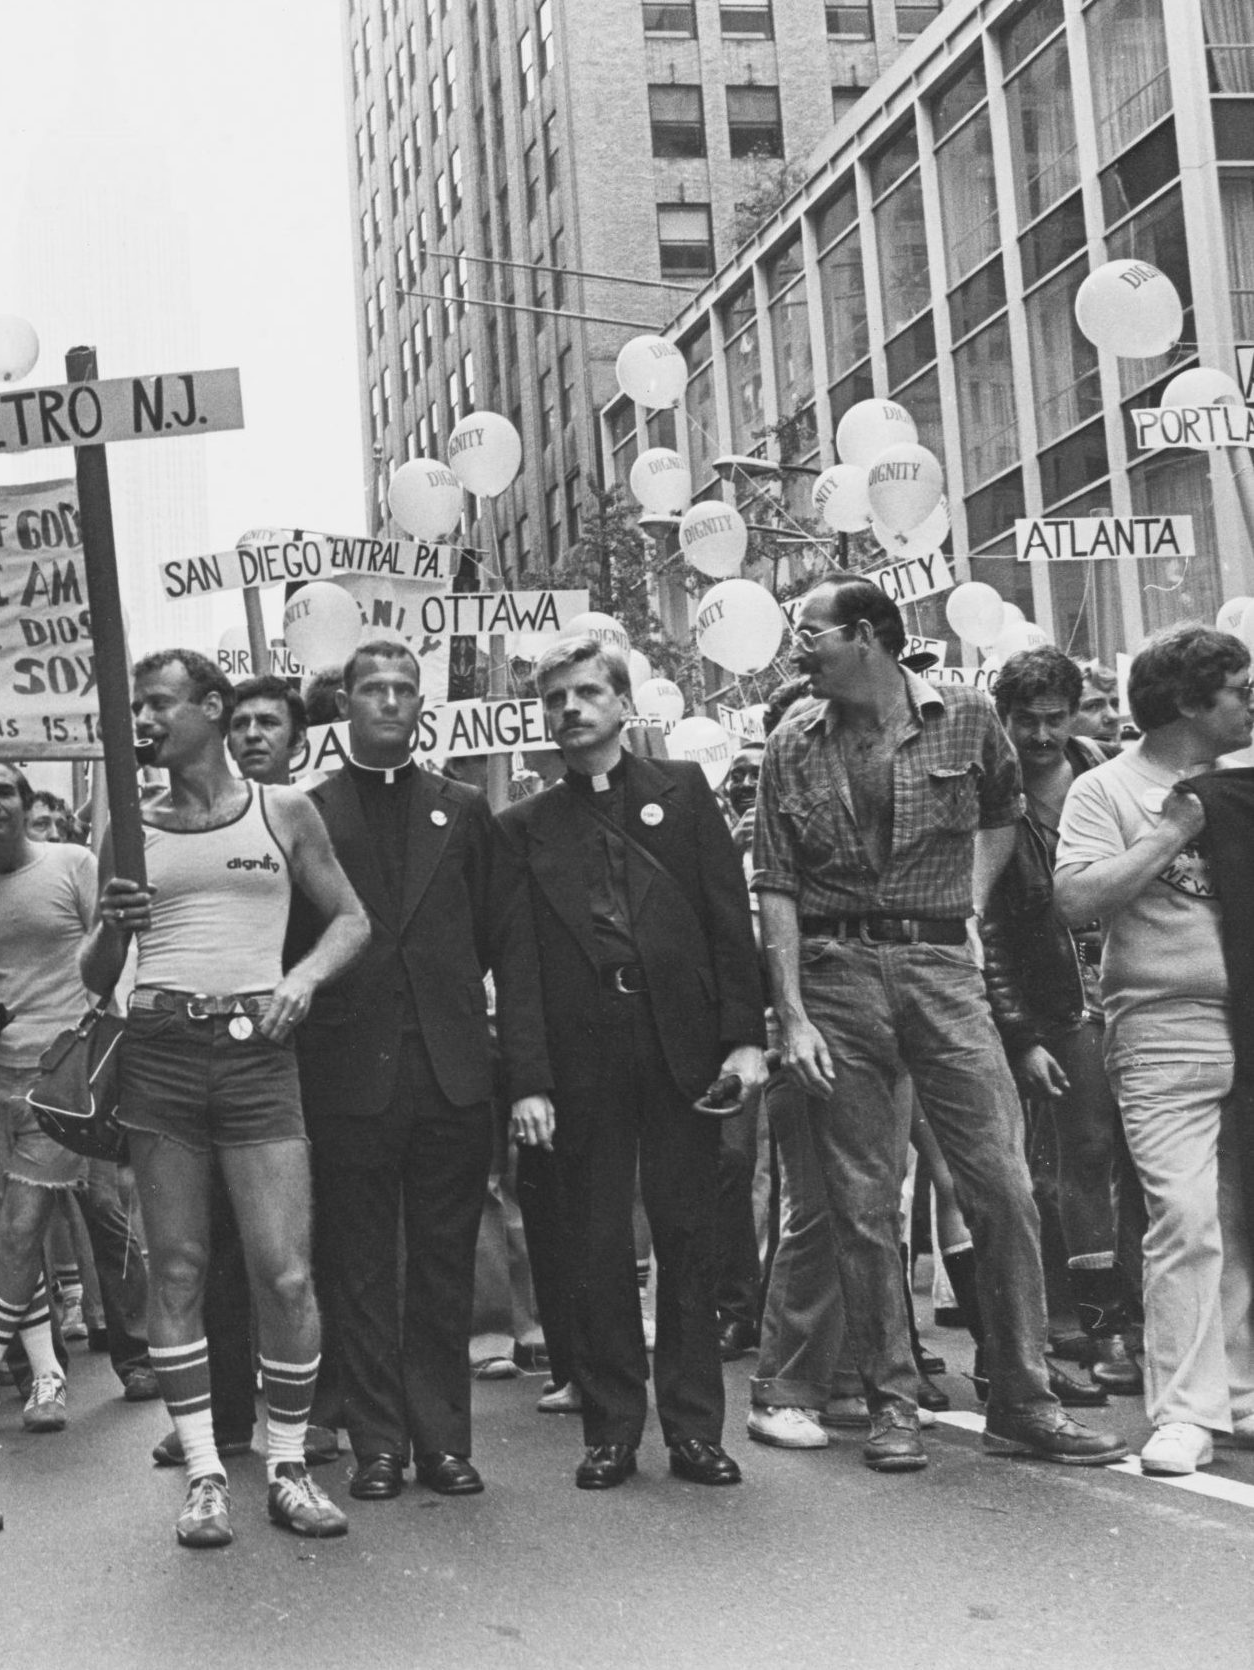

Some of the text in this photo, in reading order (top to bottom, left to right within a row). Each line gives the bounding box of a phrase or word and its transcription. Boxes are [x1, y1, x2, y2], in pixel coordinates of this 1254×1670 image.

[132, 374, 208, 433] N.J.
[869, 462, 921, 486] DIGNITY
[17, 502, 84, 550] GOD
[684, 514, 732, 545] DIGNITY
[1023, 518, 1180, 559] ATLANTA
[165, 541, 321, 598] SAN DIEGO
[413, 544, 444, 578] PA.
[879, 554, 935, 602] CITY
[20, 560, 83, 608] AM
[20, 610, 93, 648] DIOS
[422, 592, 560, 634] OTTAWA
[42, 713, 99, 743] 15:1
[227, 853, 280, 874] dignity
[1162, 864, 1214, 895] NEW
